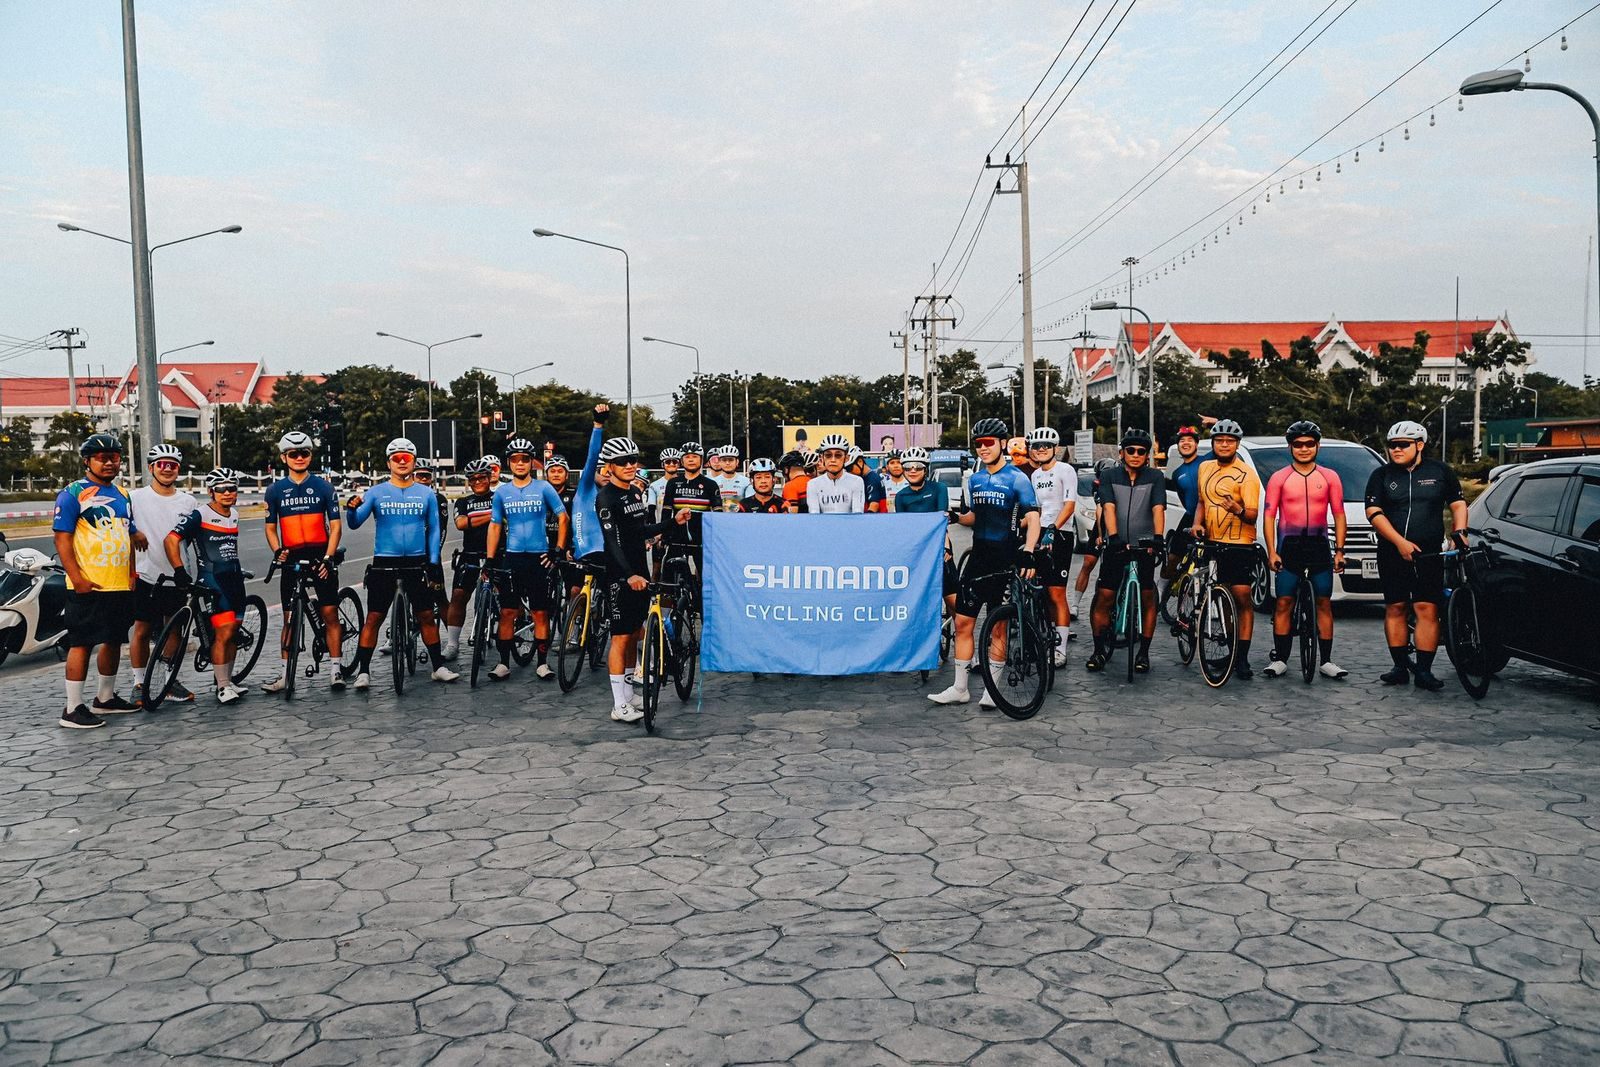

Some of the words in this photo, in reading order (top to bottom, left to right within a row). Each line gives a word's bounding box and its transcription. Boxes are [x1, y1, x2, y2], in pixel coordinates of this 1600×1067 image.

[972, 491, 1005, 499] SHIMANO
[503, 500, 542, 509] SHIMANO
[743, 564, 909, 590] SHIMANO
[745, 604, 843, 622] CYCLING
[853, 605, 908, 622] CLUB
